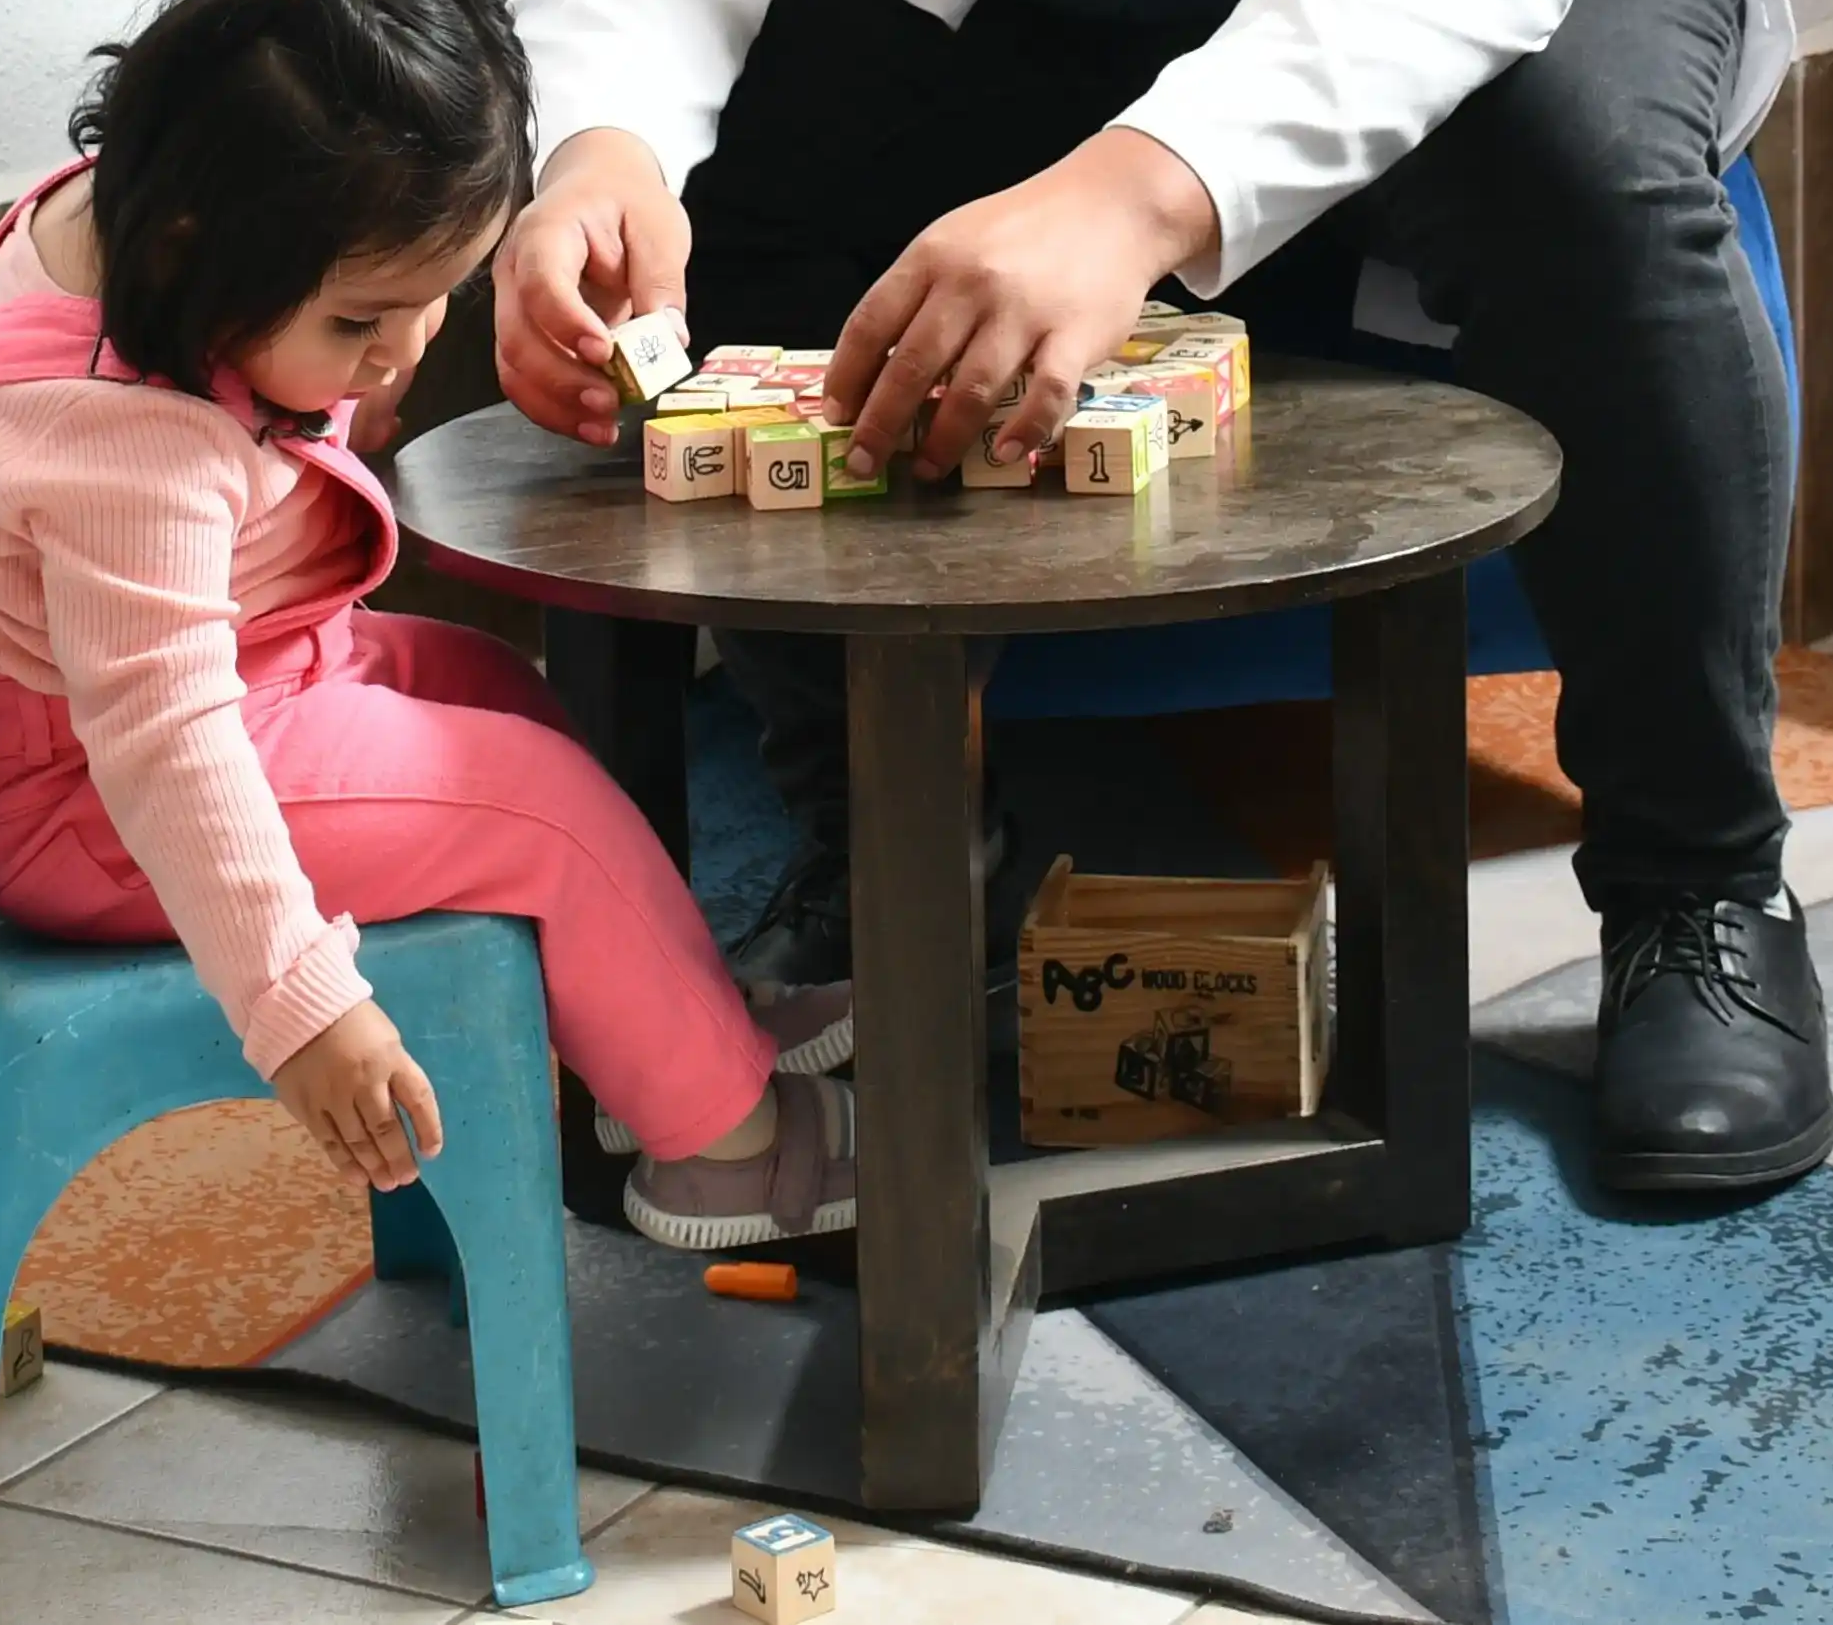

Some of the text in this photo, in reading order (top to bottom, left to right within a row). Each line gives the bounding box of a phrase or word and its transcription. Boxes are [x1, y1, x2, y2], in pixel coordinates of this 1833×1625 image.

[768, 460, 810, 491] 5
[1087, 441, 1110, 483] 1
[1042, 952, 1136, 1012] ABC
